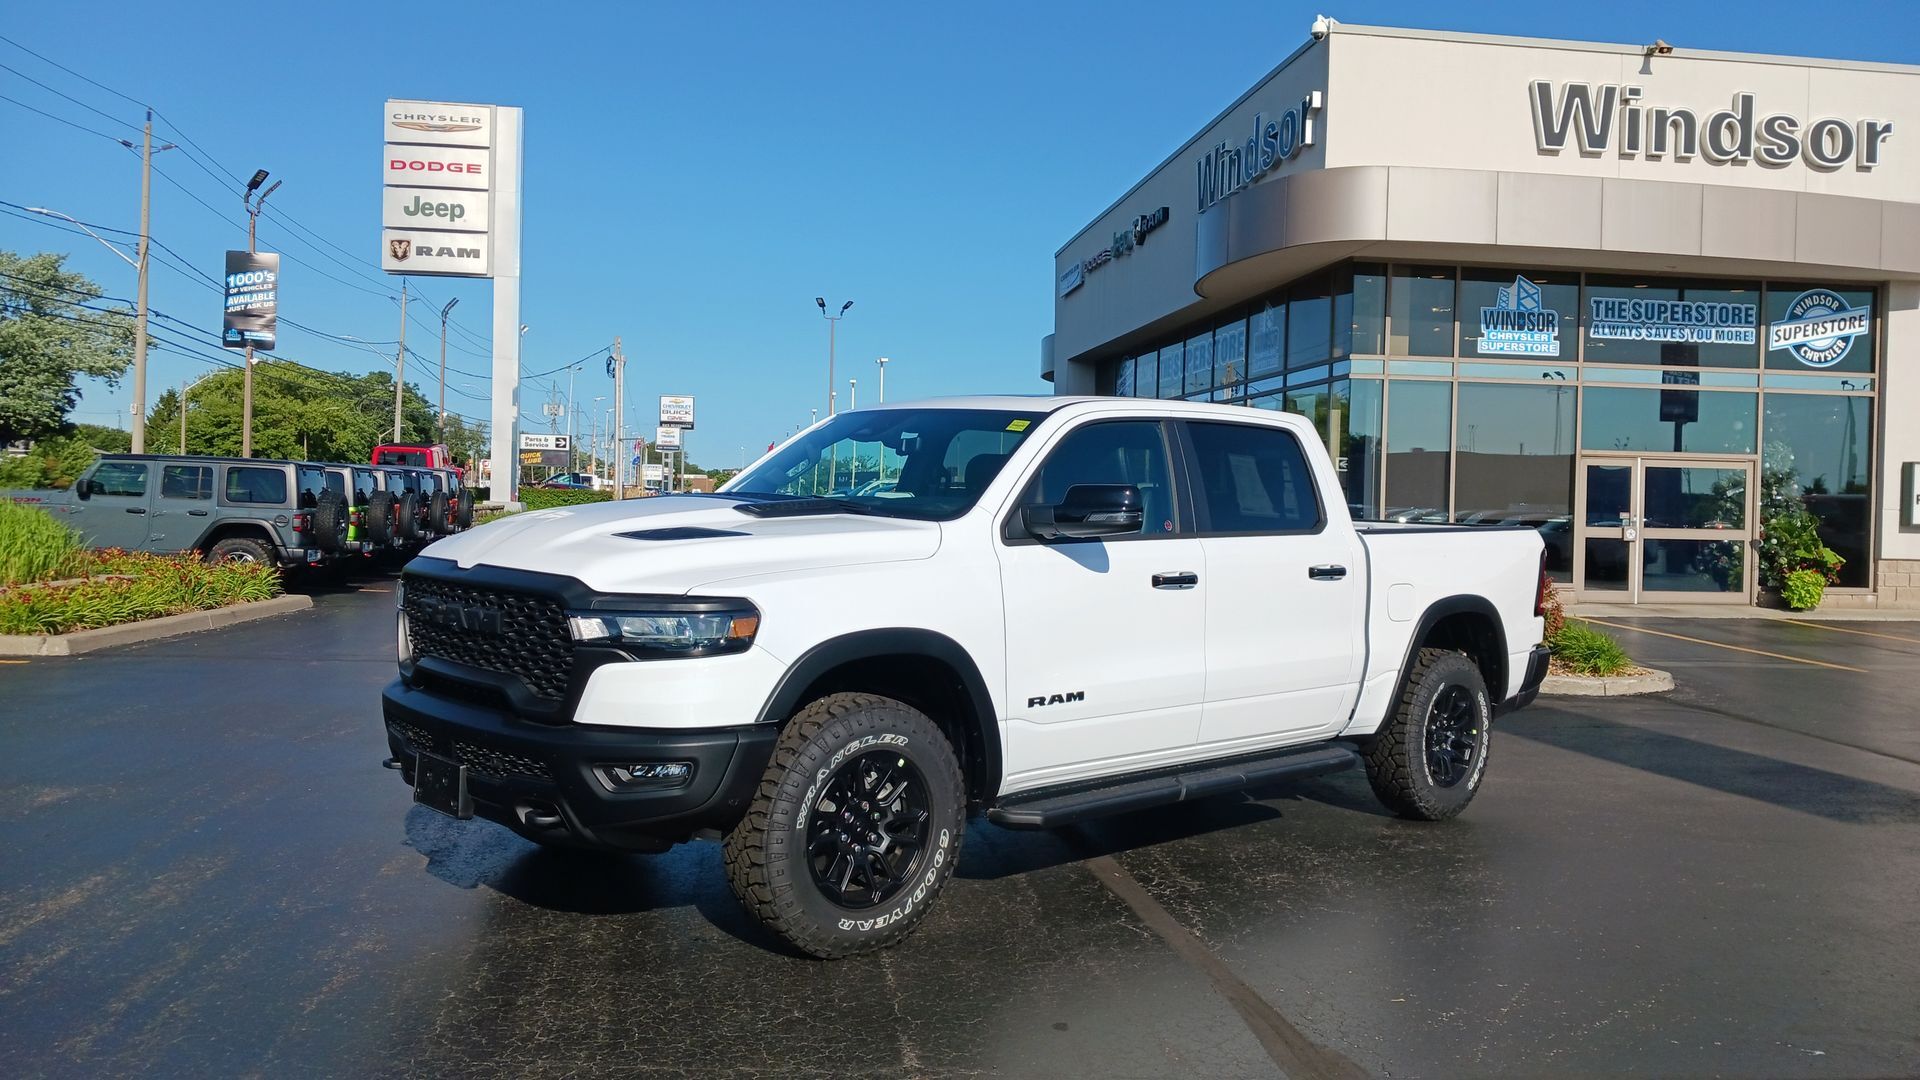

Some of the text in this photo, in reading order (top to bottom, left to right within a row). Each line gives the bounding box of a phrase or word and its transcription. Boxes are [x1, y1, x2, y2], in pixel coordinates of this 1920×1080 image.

[393, 113, 481, 124] CHRYSLER
[1529, 79, 1894, 168] Windsor
[1196, 90, 1322, 214] Windsor
[390, 160, 482, 174] DODGE
[403, 195, 465, 222] Jeep
[415, 245, 481, 259] RAM
[240, 283, 273, 292] VEHICLES
[228, 292, 275, 305] AVAILABLE
[1793, 294, 1840, 316] WINDSOR
[227, 304, 245, 312] JUST
[1593, 299, 1755, 325] THE SUPERSTORE
[1483, 310, 1556, 333] WINDSOR
[1774, 314, 1866, 343] SUPERSTORE
[1489, 332, 1549, 342] CHRYSLER
[1593, 324, 1754, 342] ALWAYS SAVES YOU MORE!
[1481, 341, 1556, 353] SUPERSTORE
[1800, 339, 1847, 362] CHRYSLER
[1028, 691, 1085, 708] RAM
[796, 733, 909, 829] WRANGLER
